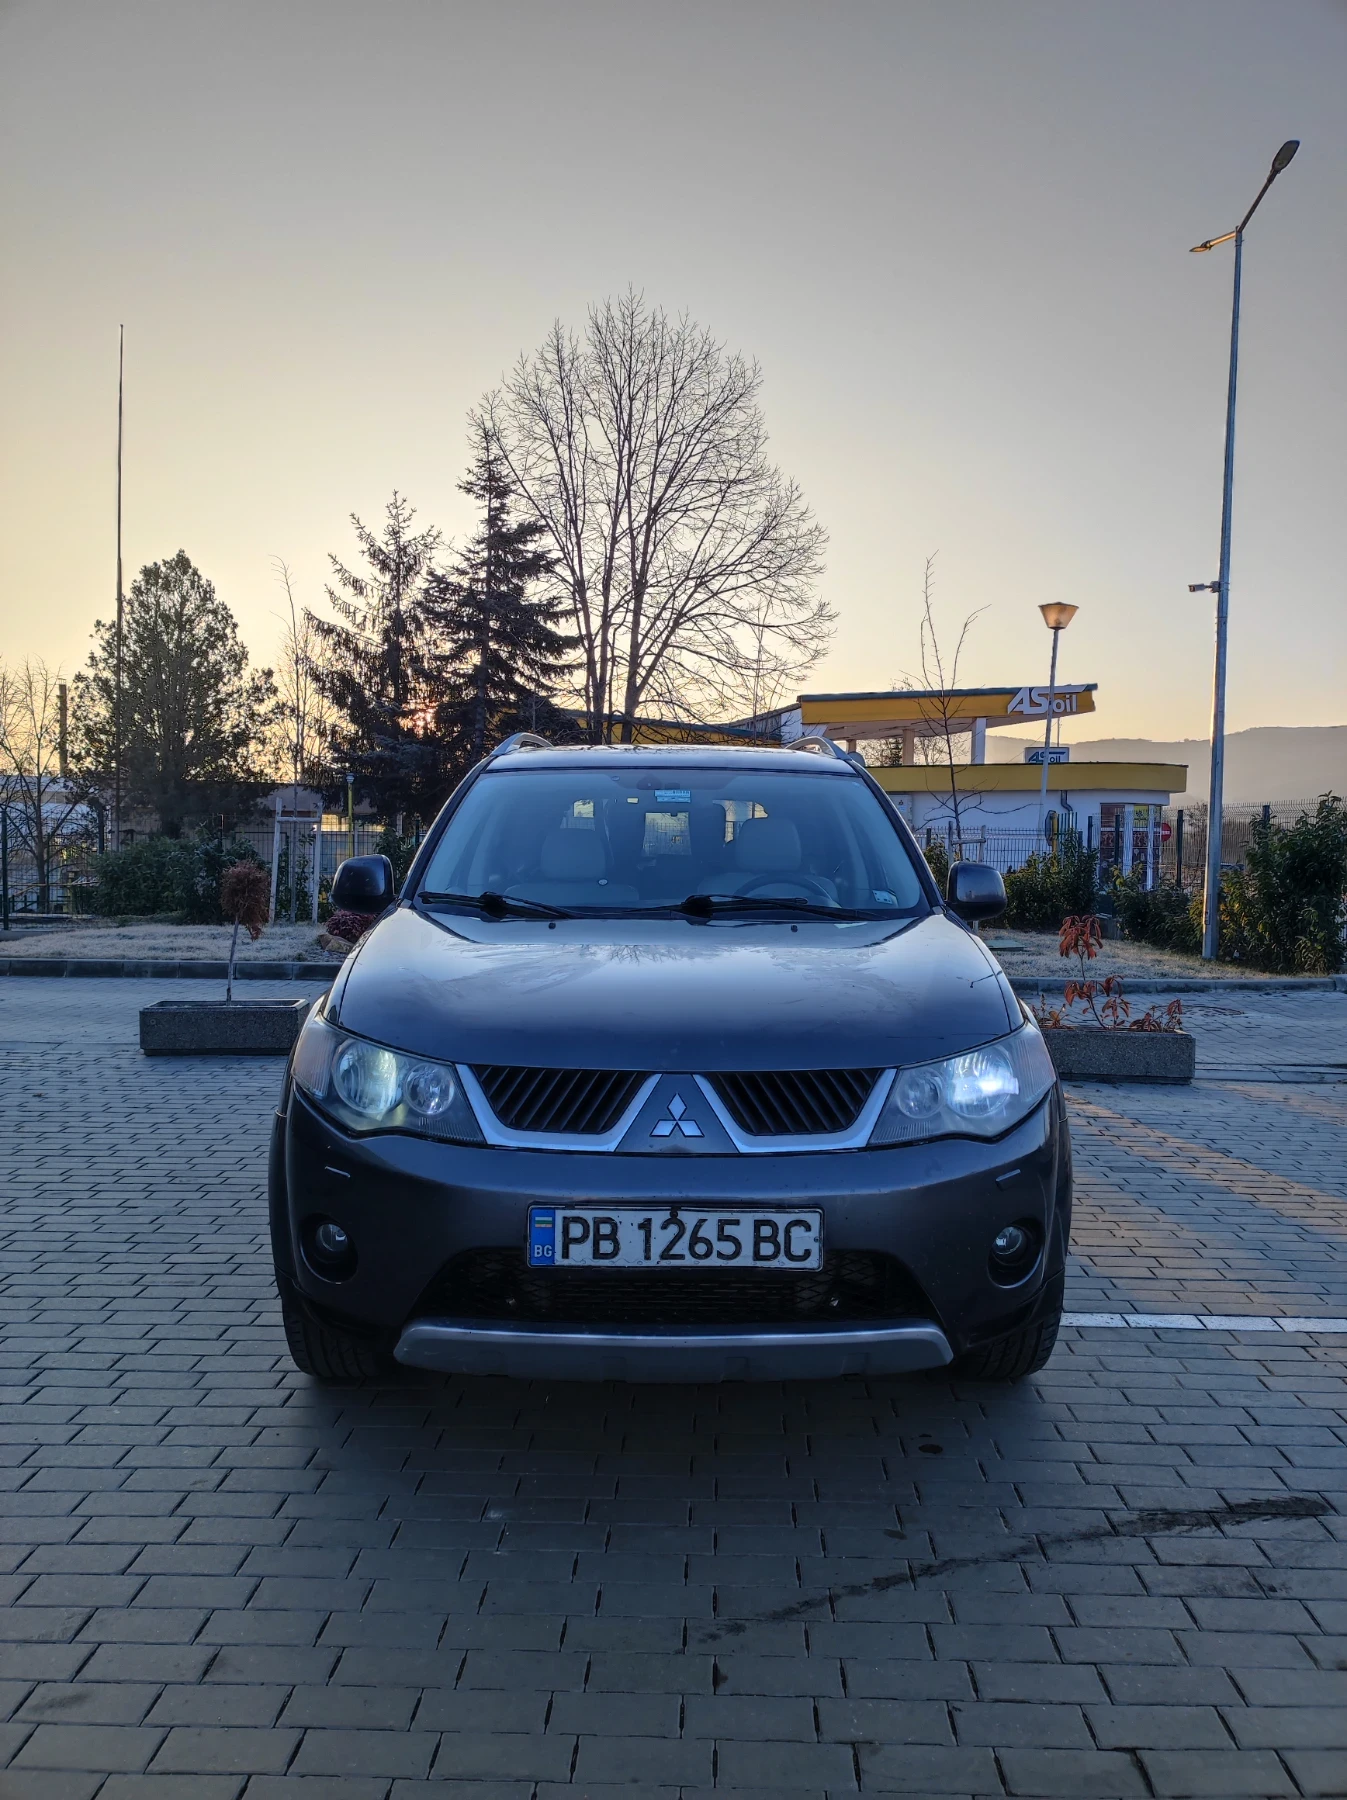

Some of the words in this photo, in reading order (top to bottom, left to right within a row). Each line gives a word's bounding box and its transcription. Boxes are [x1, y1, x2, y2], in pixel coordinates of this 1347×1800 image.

[534, 1245, 553, 1258] BG
[562, 1216, 620, 1260] PB
[638, 1217, 742, 1261] 1265
[753, 1219, 812, 1262] BC
